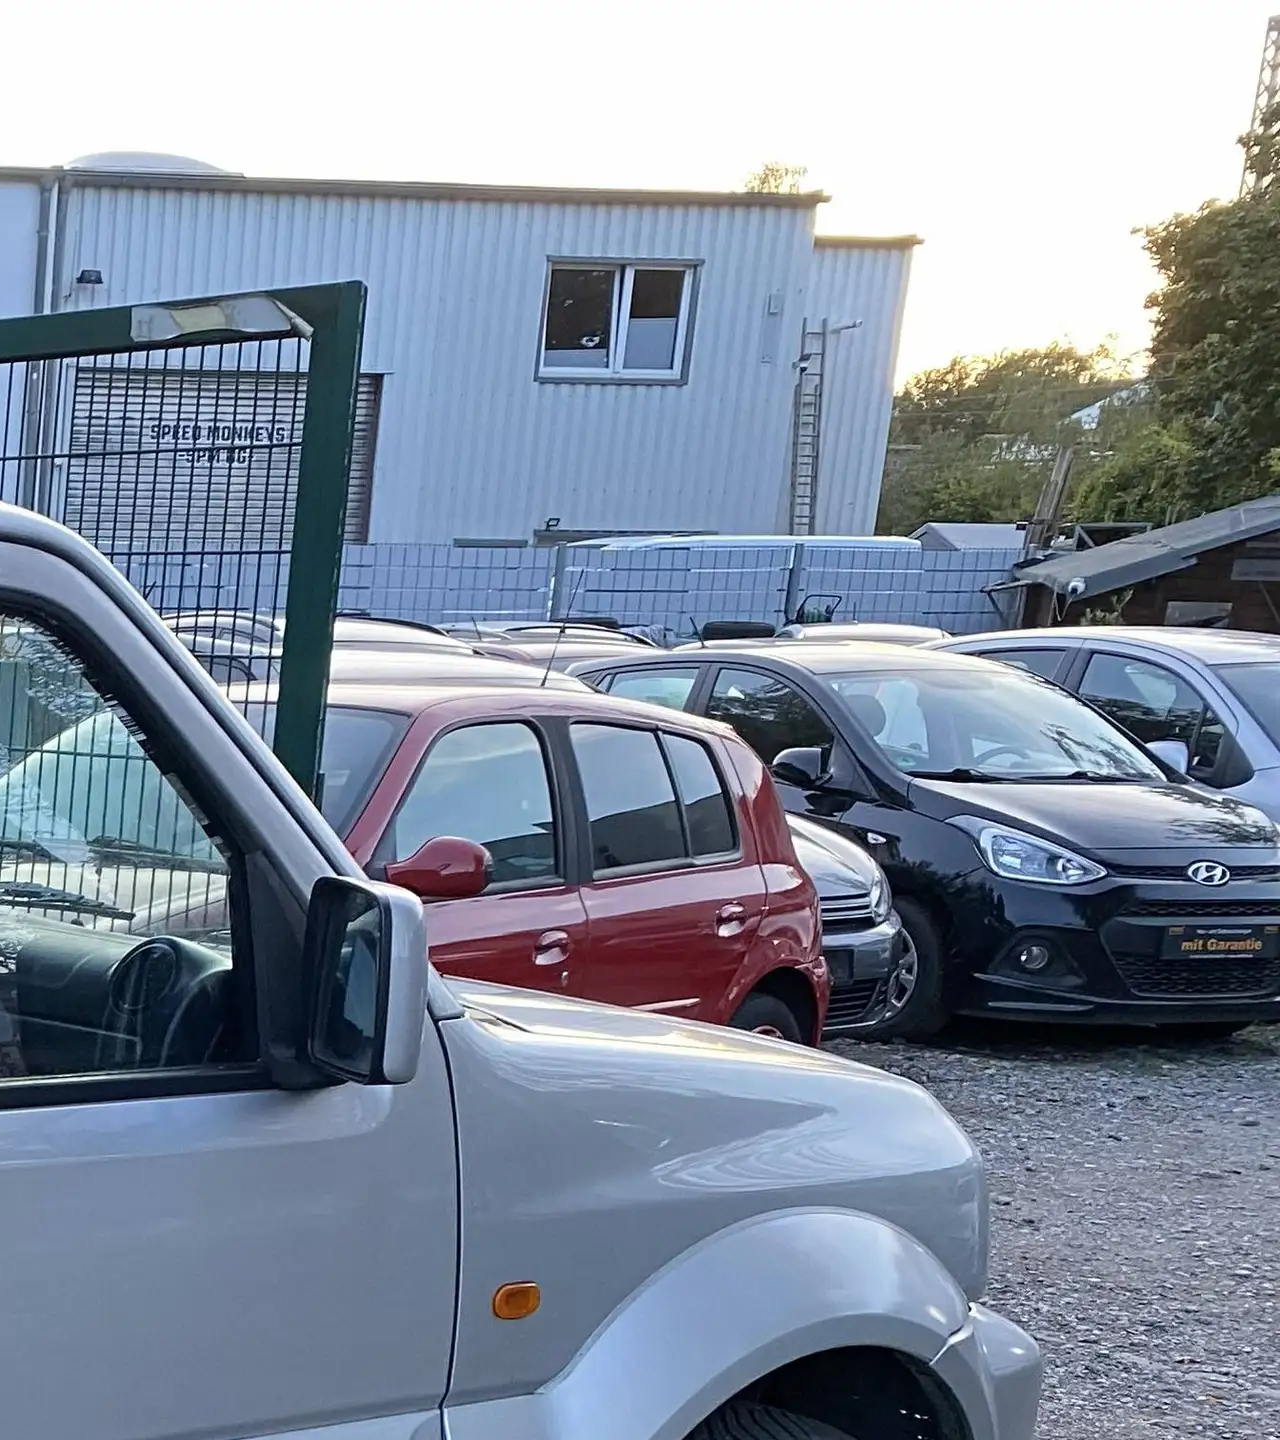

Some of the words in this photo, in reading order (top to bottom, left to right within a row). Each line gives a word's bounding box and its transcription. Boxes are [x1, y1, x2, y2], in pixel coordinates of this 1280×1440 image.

[150, 424, 201, 441] SPEED
[207, 425, 286, 443] MONKEYS
[1181, 939, 1204, 951] mit
[1207, 938, 1263, 951] Garantie
